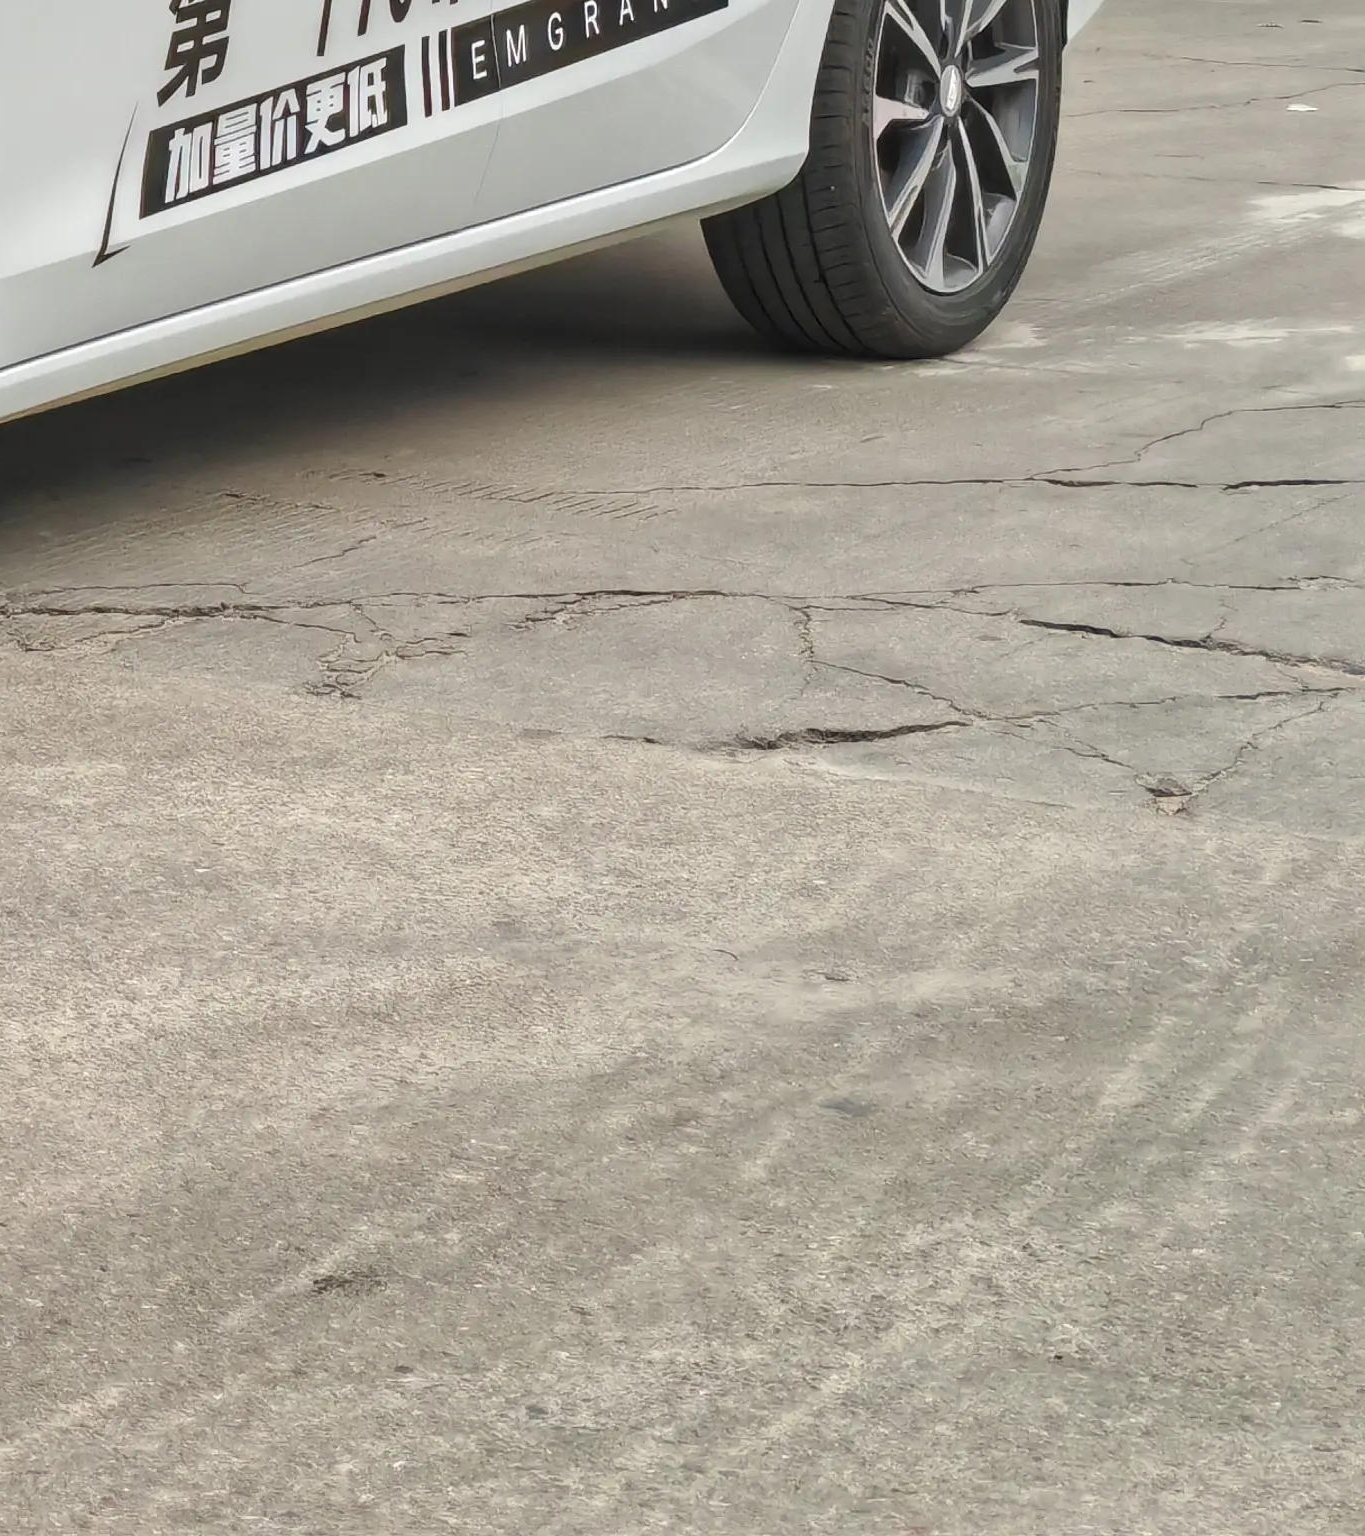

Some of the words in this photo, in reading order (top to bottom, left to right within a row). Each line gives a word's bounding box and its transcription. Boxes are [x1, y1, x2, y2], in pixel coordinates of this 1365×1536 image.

[164, 56, 388, 204] 加量价更低
